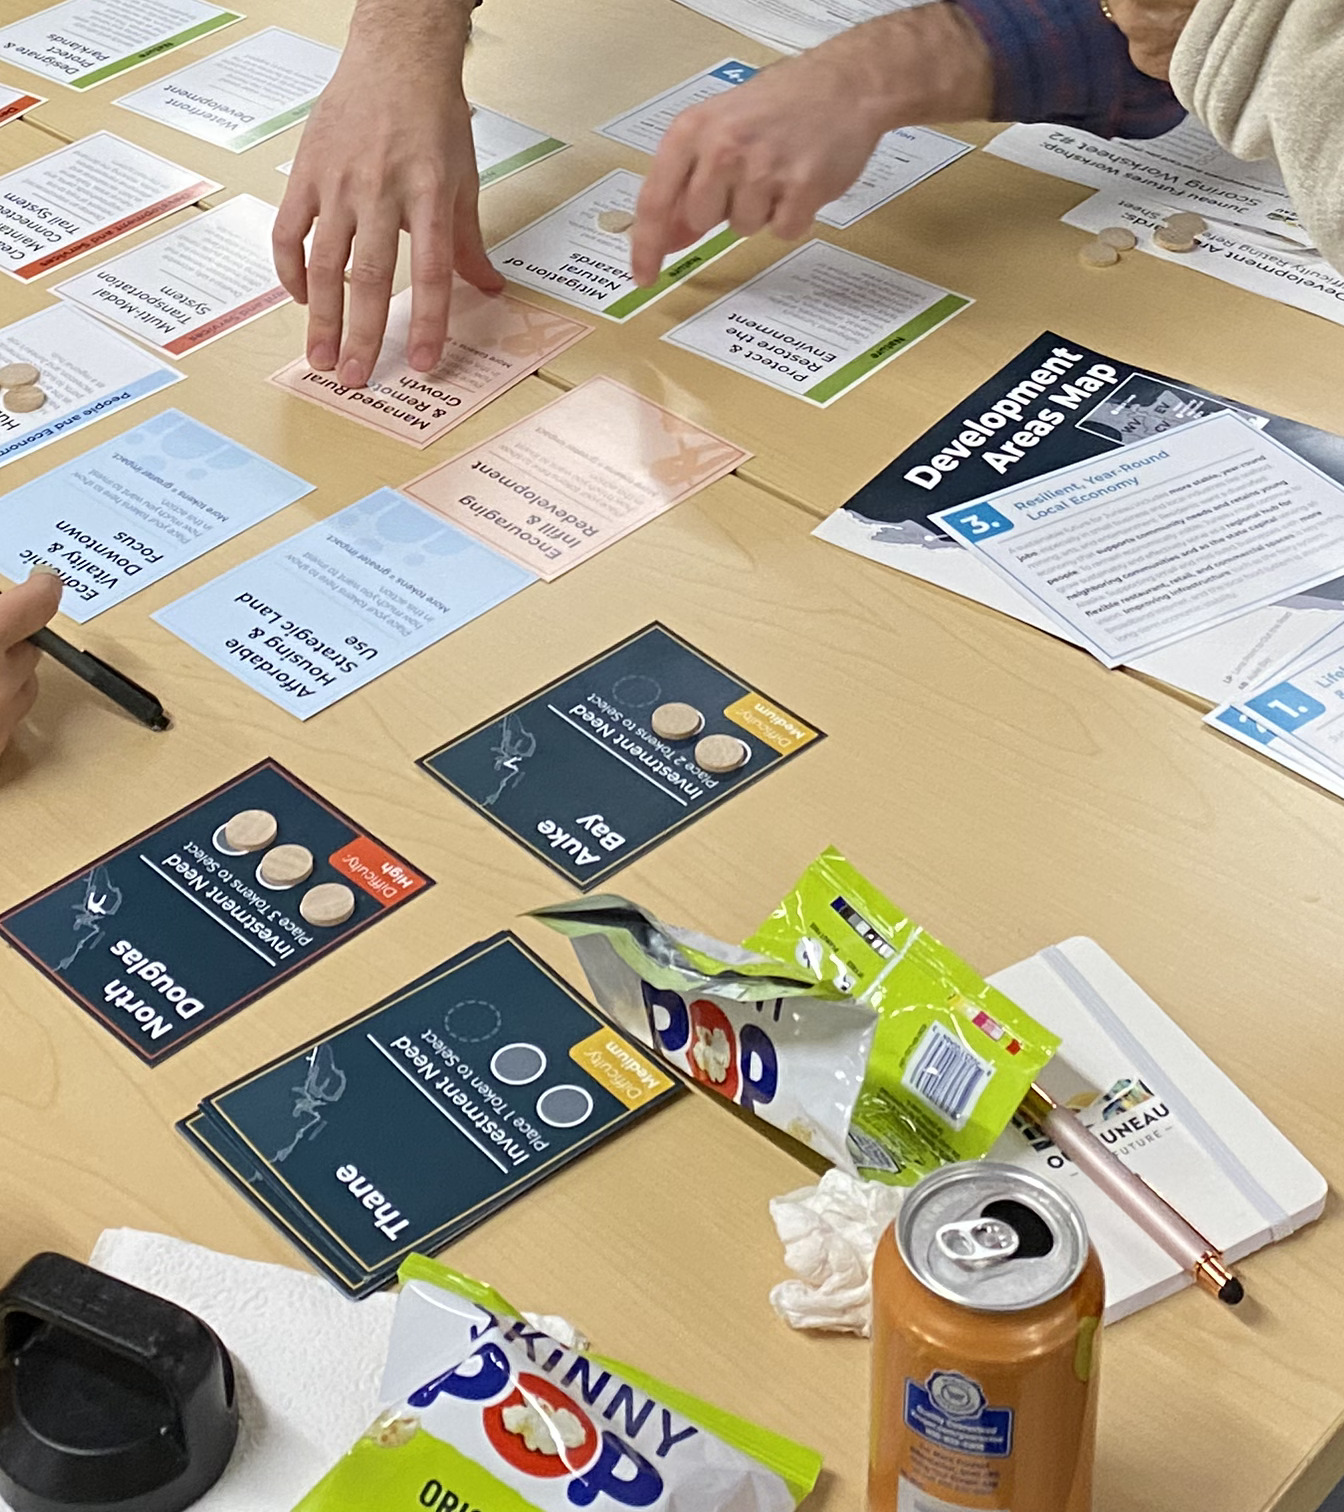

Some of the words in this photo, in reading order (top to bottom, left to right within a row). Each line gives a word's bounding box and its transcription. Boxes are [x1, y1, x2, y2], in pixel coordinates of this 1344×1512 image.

[12, 45, 81, 74] Designate
[44, 33, 111, 61] Parklands
[44, 46, 95, 67] Protect
[721, 65, 748, 84] 4.
[161, 84, 256, 123] Development
[163, 97, 240, 130] Waterfront
[1048, 132, 1076, 146] #2
[1039, 141, 1119, 176] Workshop:
[1078, 142, 1180, 182] Worksheet
[1123, 171, 1187, 198] Futures
[1184, 176, 1262, 207] Scoring
[1187, 191, 1250, 213] Juneau
[0, 191, 54, 219] System
[1117, 200, 1161, 220] Sheet
[1120, 211, 1166, 233] ards:
[46, 216, 81, 234] Trail
[569, 253, 636, 280] Hazards
[1237, 243, 1290, 267] Rating
[526, 264, 606, 299] Mitigation
[559, 263, 620, 294] Natural
[91, 288, 176, 333] Multi-Modal
[94, 270, 193, 324] Transportation
[157, 284, 213, 315] System
[723, 326, 755, 343] the
[726, 312, 837, 362] Environment
[869, 335, 906, 359] Nature
[742, 350, 809, 382] Protect
[754, 340, 823, 372] Restore
[301, 371, 351, 396] Rural
[397, 375, 462, 407] Growth
[53, 413, 82, 429] and
[81, 391, 131, 416] People
[347, 390, 431, 430] Managed
[901, 346, 1086, 490] Development
[977, 406, 1068, 474] Areas
[1047, 361, 1122, 410] Map
[1011, 481, 1087, 511] Resilient,
[1081, 449, 1171, 485] Year-Round
[469, 459, 599, 537] Redevelopment
[1025, 500, 1071, 521] Local
[1068, 476, 1141, 506] Economy
[456, 494, 562, 560] Encouraging
[536, 521, 581, 549] Infill
[958, 512, 1001, 535] 3.
[53, 520, 143, 576] Downtown
[111, 531, 164, 563] Focus
[355, 553, 392, 575] greater
[16, 549, 99, 601] Econic
[58, 549, 121, 589] Vitality
[394, 577, 427, 598] tokens
[424, 595, 451, 613] More
[233, 592, 282, 624] Land
[261, 635, 337, 687] Housing
[277, 619, 359, 674] Strategic
[342, 635, 379, 660] Use
[222, 637, 315, 698] Affordable
[567, 703, 617, 738] Need
[584, 692, 625, 721] Select
[751, 702, 806, 739] Medium
[1266, 695, 1310, 720] 1.
[633, 727, 677, 760] Tokens
[733, 707, 793, 748] Difficulty:
[610, 733, 704, 800] Investment
[682, 761, 720, 789] Place
[533, 818, 601, 867] Auke
[573, 811, 628, 851] Bay
[161, 852, 211, 891] Need
[181, 840, 221, 872] Select
[339, 853, 399, 898] Difficulty:
[379, 861, 414, 888] High
[227, 878, 272, 914] Tokens
[203, 885, 296, 959] Investment
[276, 916, 314, 946] Place
[107, 937, 206, 1019] Douglas
[100, 978, 173, 1039] North
[388, 1034, 441, 1080] Need
[418, 1028, 461, 1067] Select
[641, 979, 778, 1114] POP
[581, 1046, 644, 1100] Difficulty:
[602, 1040, 661, 1089] Medium
[467, 1075, 510, 1115] Token
[432, 1075, 531, 1166] Investment
[510, 1115, 551, 1151] Place
[1086, 1104, 1170, 1144] UNEAU
[331, 1162, 412, 1240] Thane
[406, 1342, 664, 1507] POP
